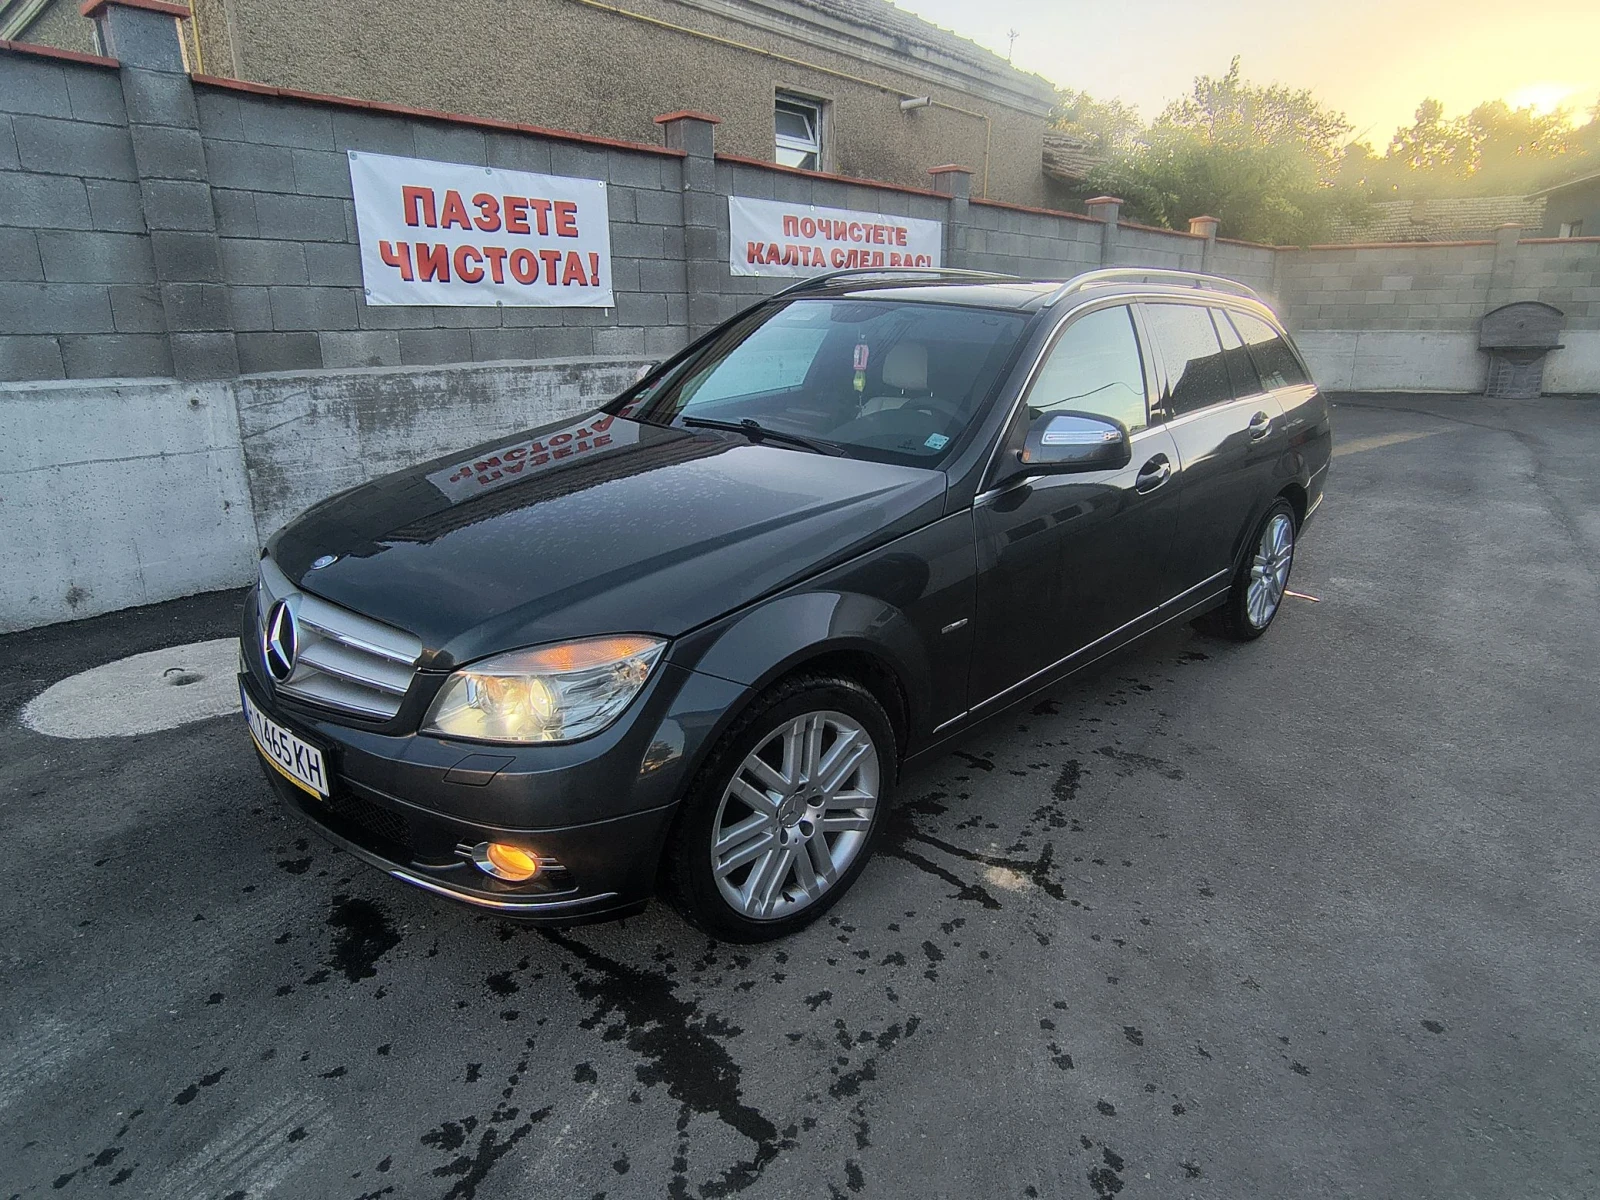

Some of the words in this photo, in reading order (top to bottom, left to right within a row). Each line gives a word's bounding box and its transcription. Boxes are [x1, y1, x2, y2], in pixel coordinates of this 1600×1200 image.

[402, 185, 579, 238] ПАЗЕТЕ
[782, 214, 908, 247] ПОЧИСТЕТЕ
[378, 240, 600, 287] ЧИСТОТА!
[746, 241, 827, 268] КАЛТА
[830, 248, 885, 269] СЛЕД
